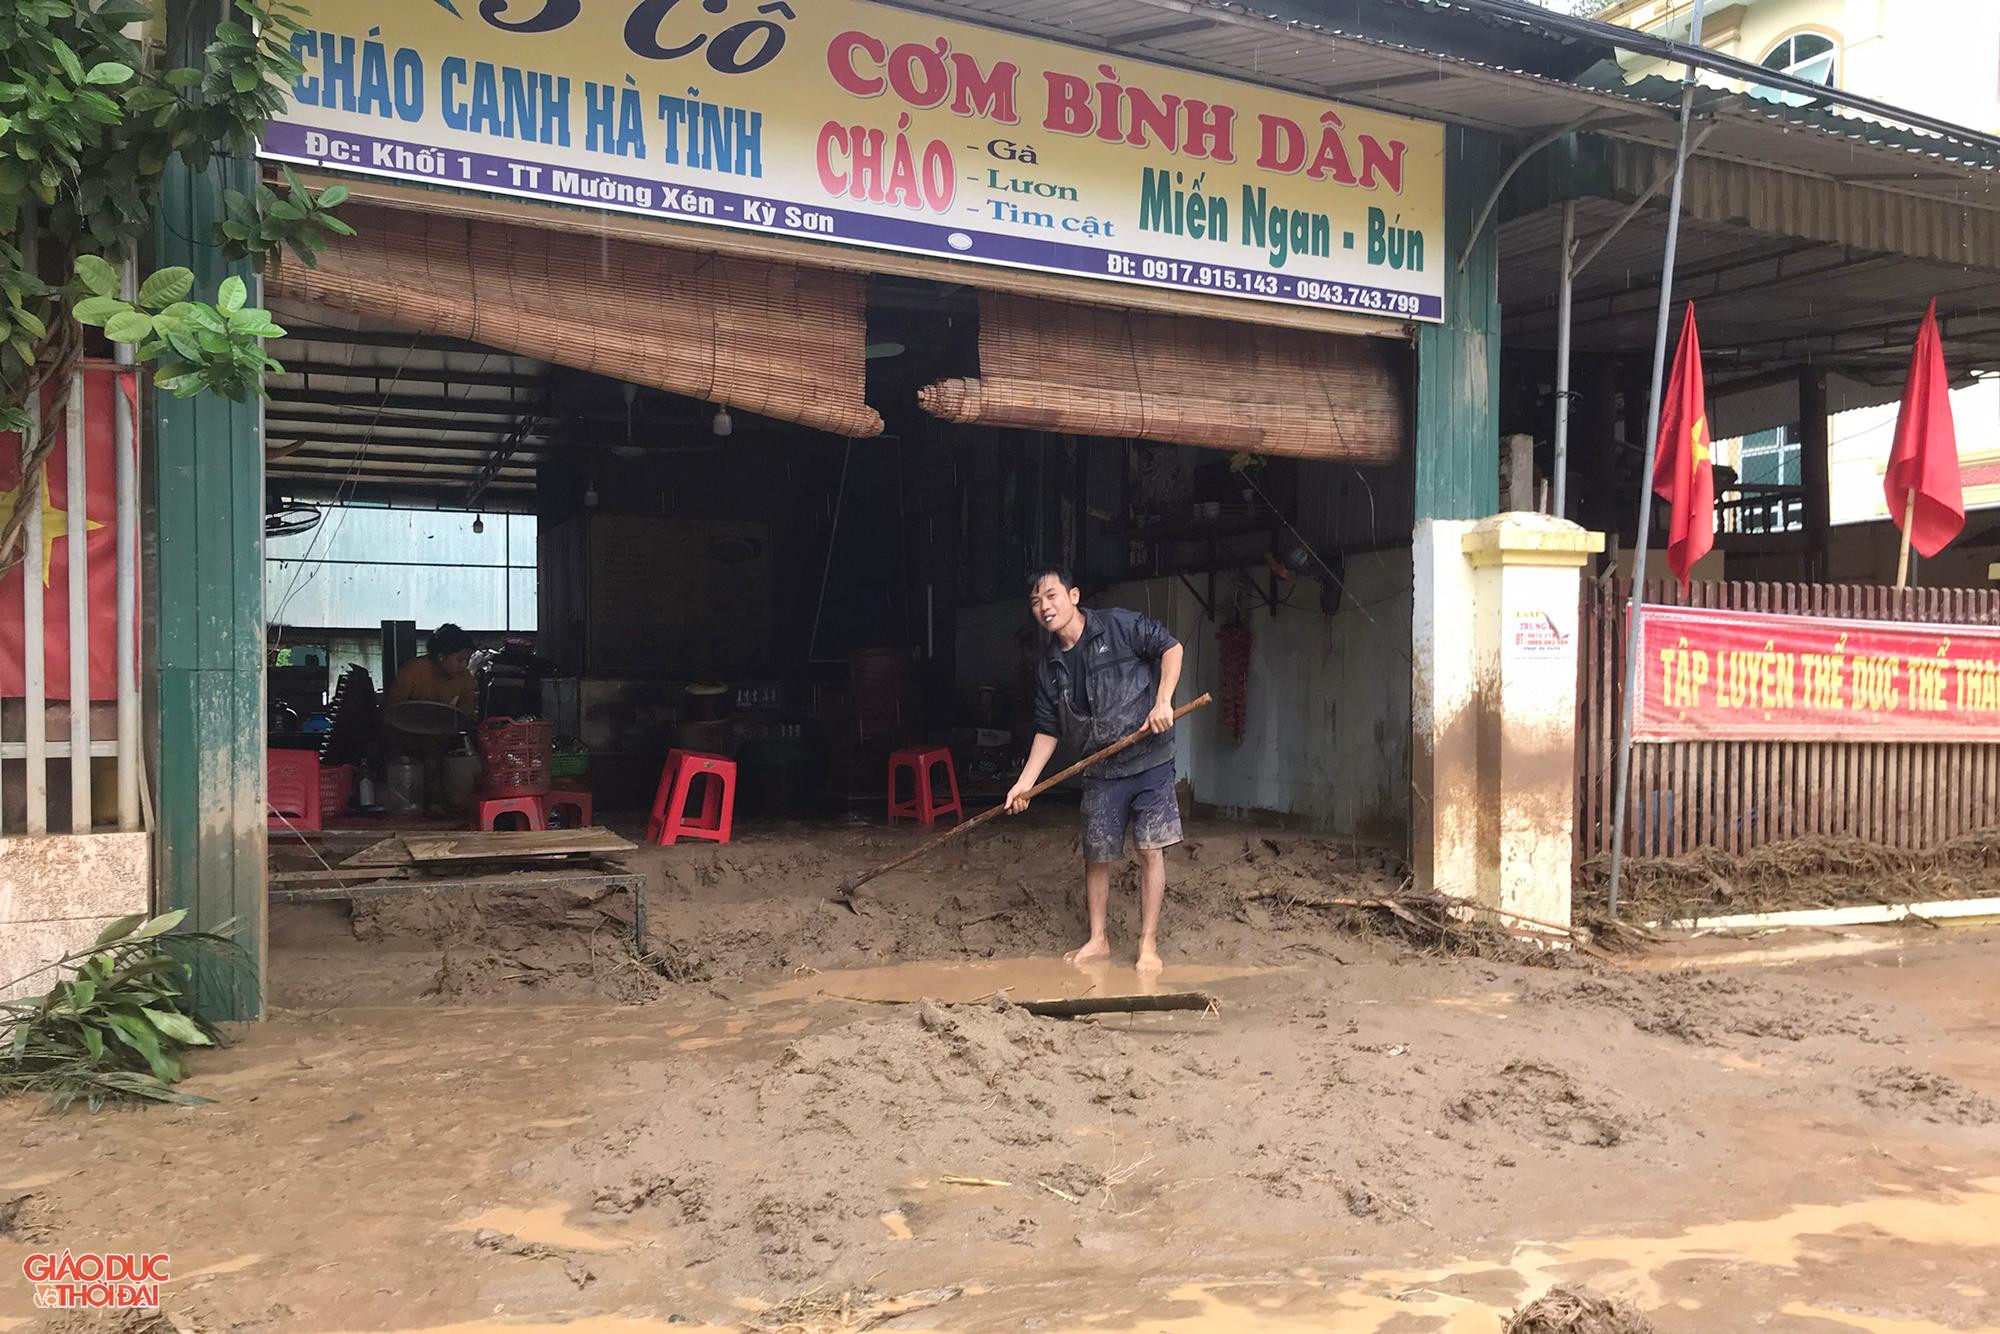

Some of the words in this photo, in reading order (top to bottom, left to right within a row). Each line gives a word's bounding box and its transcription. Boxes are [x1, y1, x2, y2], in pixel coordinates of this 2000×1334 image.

[290, 26, 423, 123] CHÁO
[442, 56, 571, 148] CANH
[585, 73, 646, 160] HÀ
[658, 86, 762, 178] TĨNH
[827, 30, 1020, 125] CƠM
[1042, 64, 1237, 163] BÌNH
[1257, 110, 1407, 195] DÂN
[305, 131, 360, 163] Đc:
[372, 141, 446, 176] Khối
[458, 157, 472, 179] 1
[508, 163, 542, 188] TT
[552, 170, 652, 207] Mường
[661, 186, 715, 215] Xén
[743, 199, 776, 226] Kỳ
[785, 206, 835, 233] Sơn
[816, 111, 956, 214] CHÁO
[987, 139, 1039, 165] Gà
[987, 169, 1079, 201] Lươn
[987, 199, 1055, 228] Tim
[1061, 216, 1115, 238] cật
[1139, 166, 1228, 243] Miến
[1242, 184, 1330, 268] Ngan
[1368, 206, 1424, 272] Bún
[1107, 253, 1136, 276] Đt:
[1142, 258, 1278, 294] 0917.915.143
[1297, 280, 1420, 314] 0943.743.799
[1660, 637, 1709, 720] TẬP
[1716, 640, 1794, 720] LUYỆN
[1801, 632, 1847, 709] THỂ
[1852, 656, 1899, 722] DỤC
[1908, 637, 1950, 711] THỂ
[1955, 659, 2000, 711] THA
